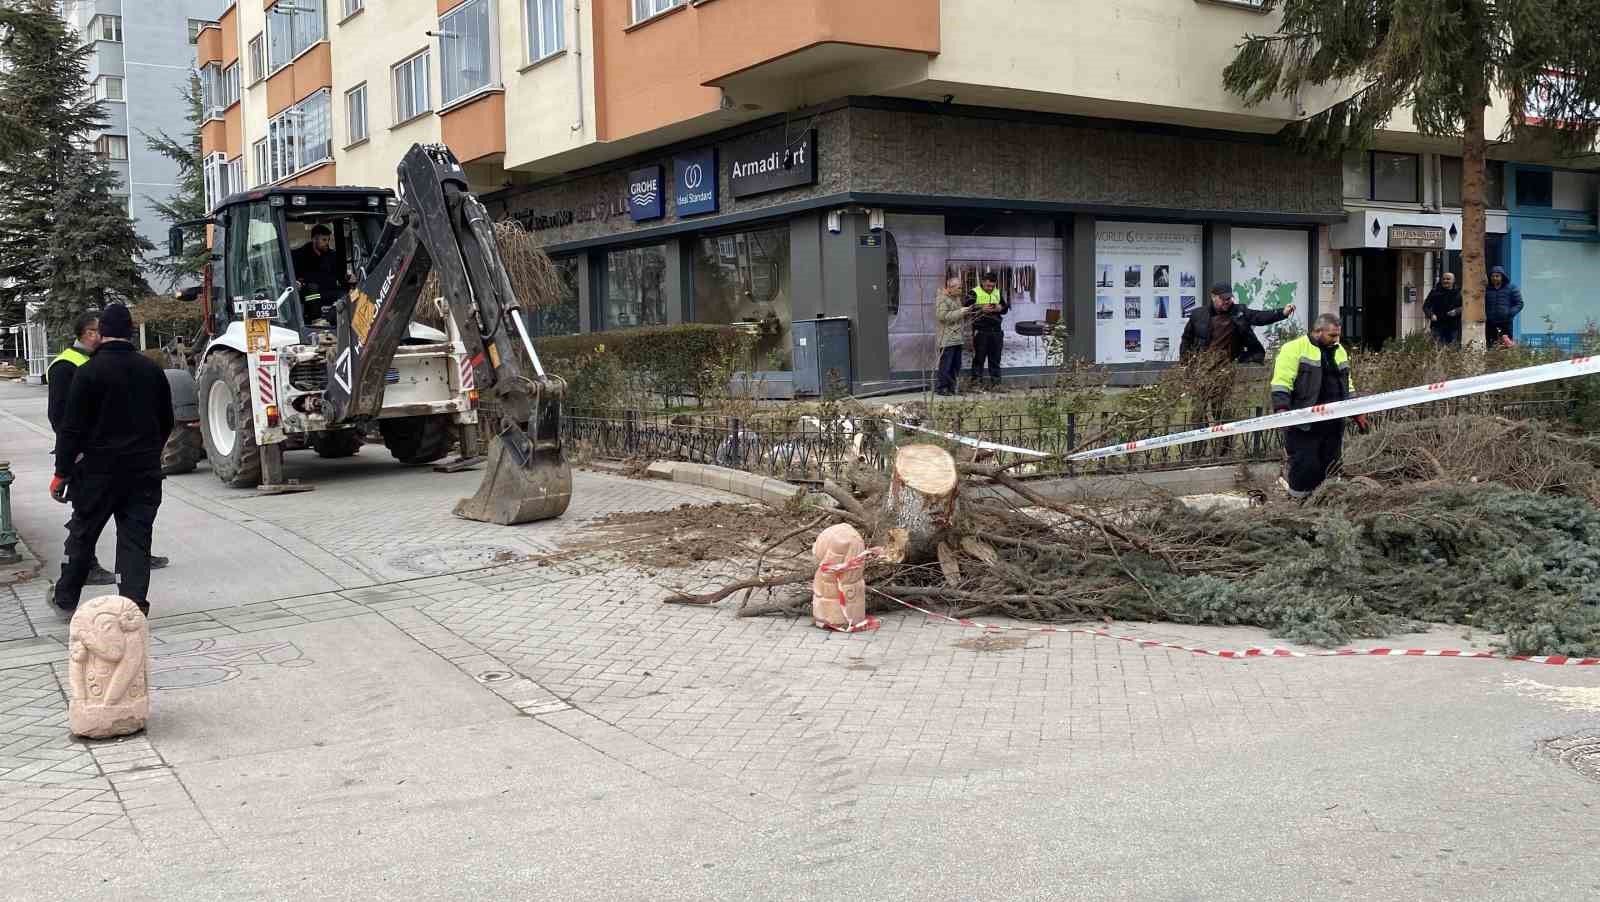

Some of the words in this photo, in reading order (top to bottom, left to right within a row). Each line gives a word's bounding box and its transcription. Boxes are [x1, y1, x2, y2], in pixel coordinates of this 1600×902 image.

[732, 152, 779, 179] Armadi
[630, 179, 657, 194] GROHE
[688, 190, 713, 202] Standard
[1095, 231, 1124, 242] WORLD
